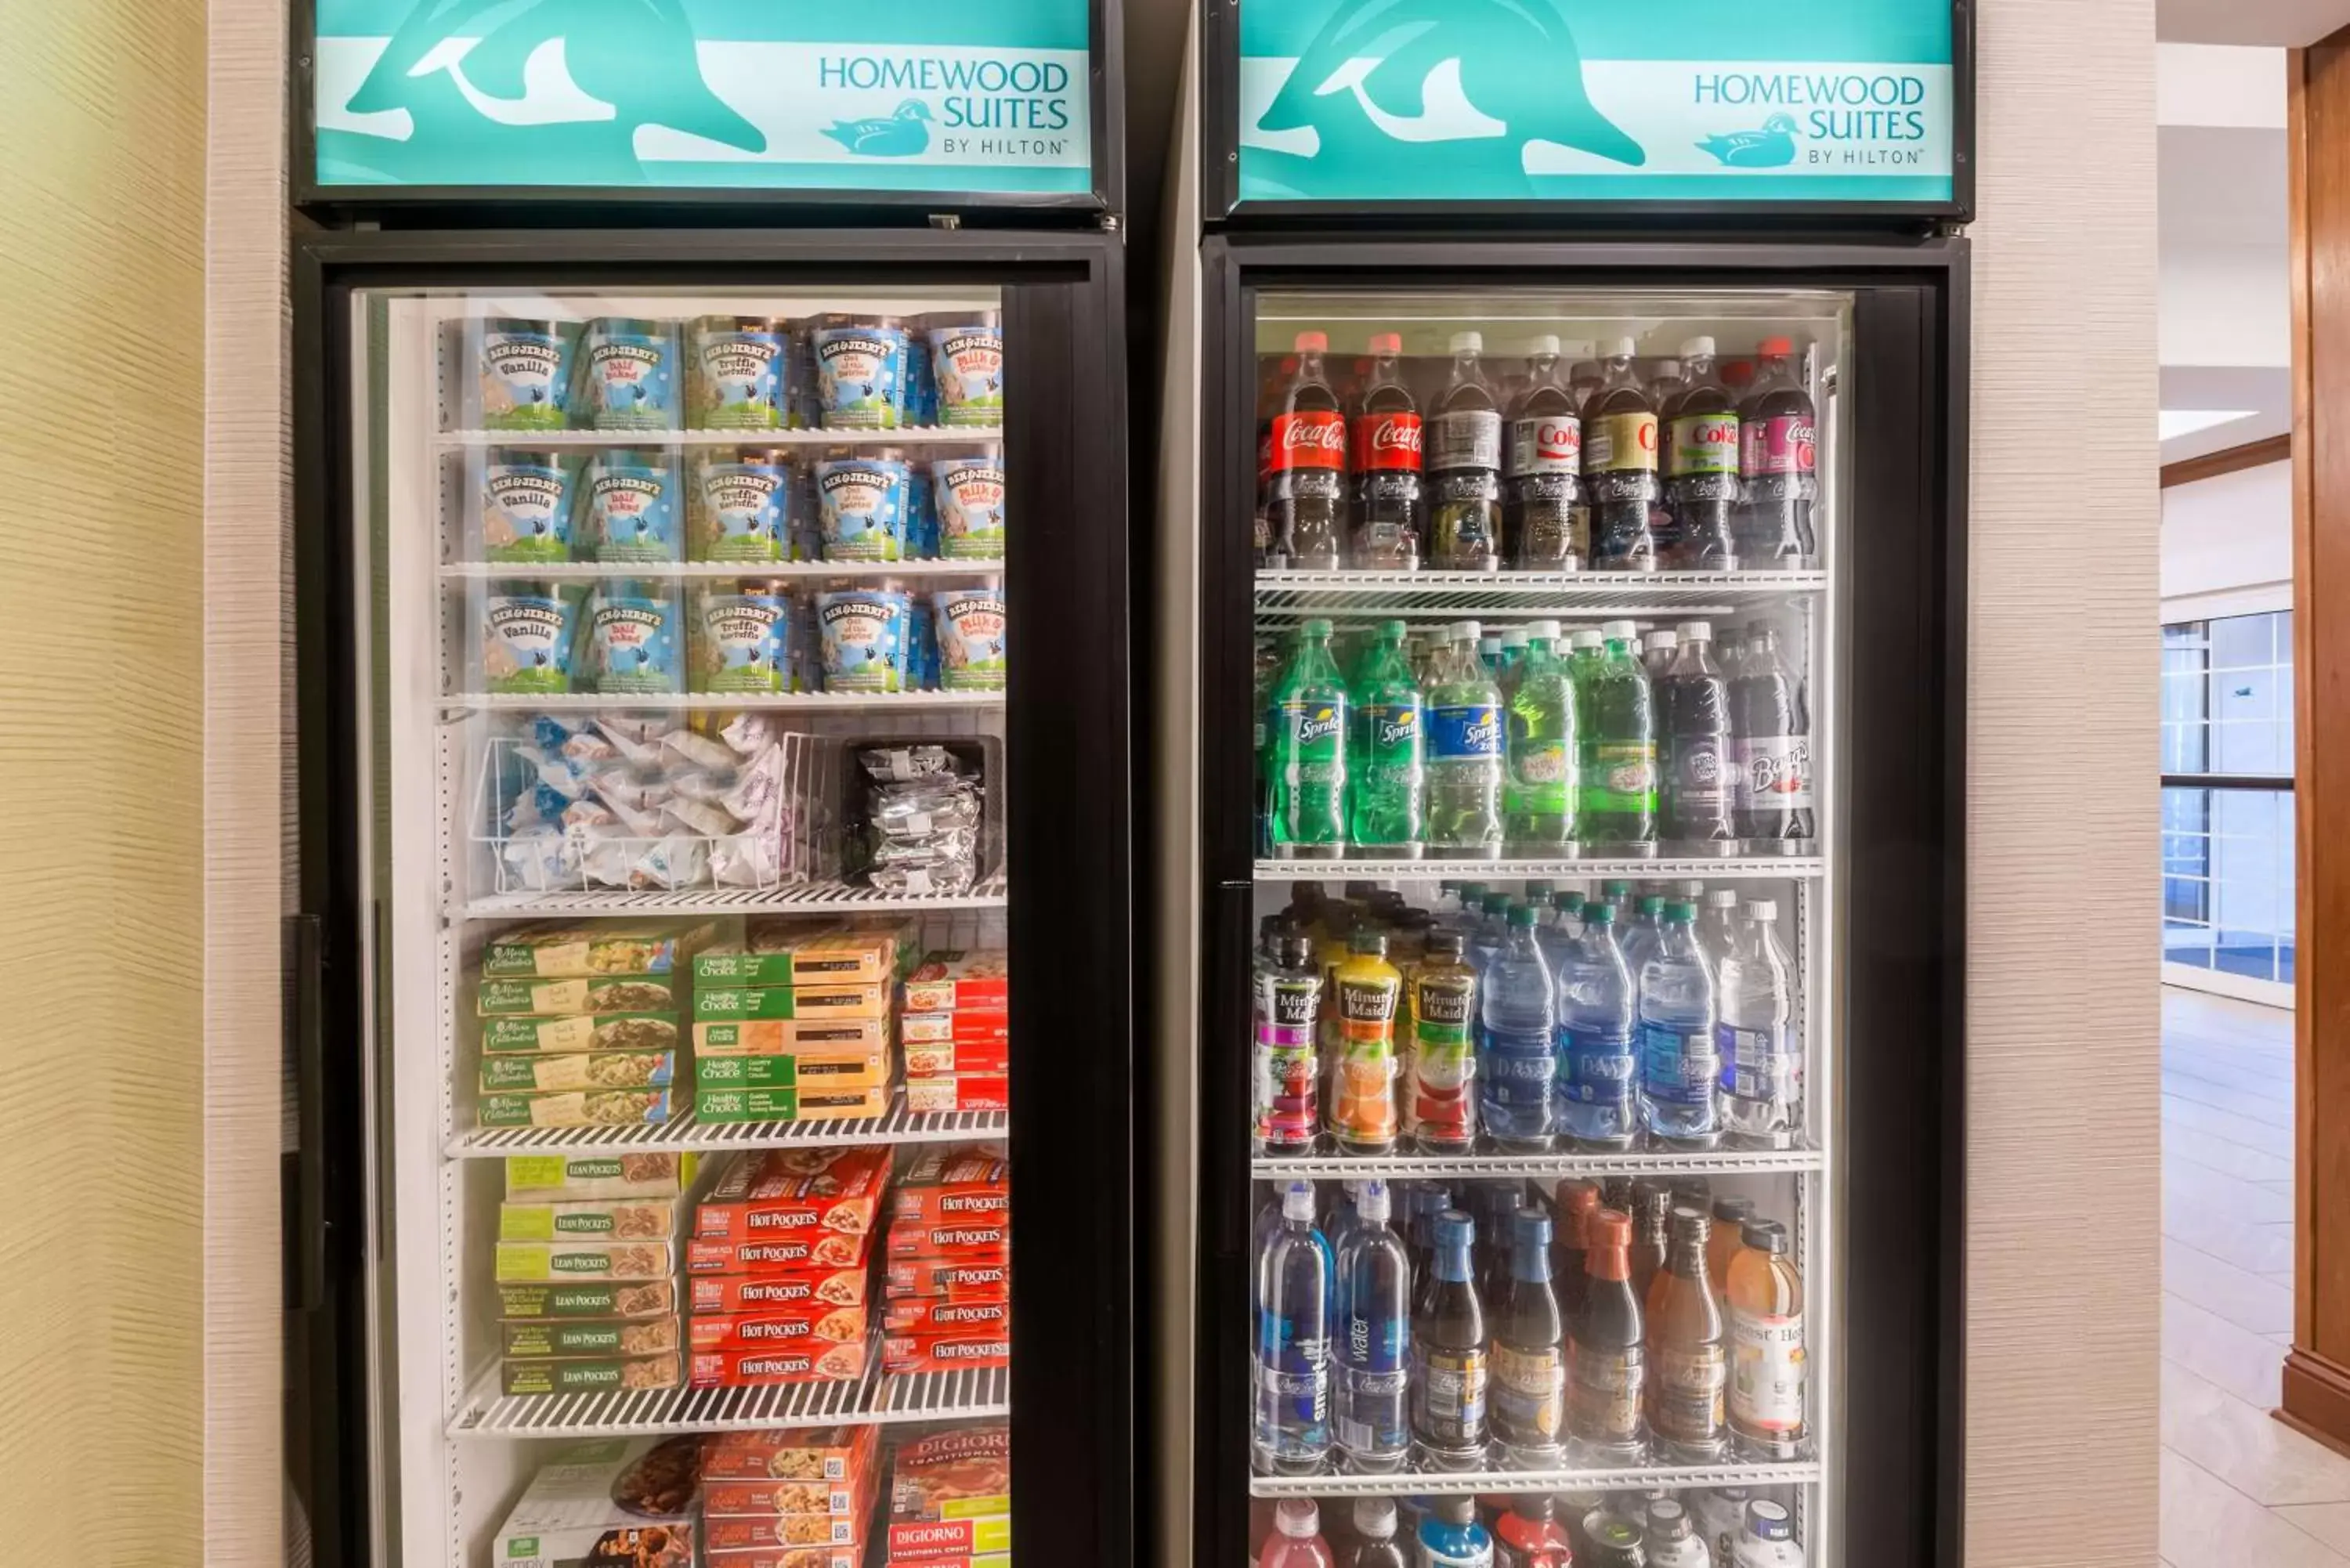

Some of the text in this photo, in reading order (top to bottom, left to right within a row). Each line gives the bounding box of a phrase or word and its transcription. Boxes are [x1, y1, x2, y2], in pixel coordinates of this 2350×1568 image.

[819, 57, 1068, 92] HOMEWOOD
[1694, 74, 1925, 105] HOMEWOOD
[943, 96, 1068, 129] SUITES
[1809, 110, 1925, 140] SUITES
[943, 139, 970, 153] BY
[1809, 150, 1833, 164] BY
[705, 958, 737, 970] Healthy
[700, 966, 738, 977] Choice
[706, 992, 739, 1003] Healthy
[700, 1001, 739, 1011] Choice
[1351, 1003, 1386, 1017] Maid
[1429, 1005, 1463, 1019] Maid
[707, 1060, 740, 1070] Healthy
[702, 1068, 740, 1078] Choice
[707, 1093, 741, 1104] Healthy
[703, 1101, 742, 1113] Choice
[569, 1164, 588, 1175] LEAN
[589, 1163, 620, 1175] POCKETS
[942, 1198, 964, 1210] HOT
[558, 1217, 611, 1229] LEAN POCKETS
[750, 1212, 817, 1227] HOT POCKETS
[933, 1232, 955, 1245] HOT
[956, 1229, 1000, 1243] POCKETS
[740, 1244, 808, 1260] HOT POCKETS
[554, 1256, 609, 1268] LEAN POCKETS
[958, 1269, 1003, 1282] POCKETS
[743, 1284, 811, 1300] HOT POCKETS
[555, 1294, 610, 1306] LEAN POCKETS
[935, 1306, 1002, 1322] HOT POCKETS
[742, 1324, 762, 1338] HOT
[764, 1321, 809, 1336] POCKETS
[563, 1332, 580, 1344] LEAN
[582, 1332, 616, 1344] POCKETS
[1351, 1317, 1369, 1362] water
[936, 1342, 1005, 1357] HOT POCKETS
[743, 1358, 809, 1375] HOT POCKETS
[564, 1371, 581, 1382] LEAN
[583, 1370, 618, 1382] POCKETS
[918, 1434, 1009, 1453] DIGIOR
[909, 1450, 1000, 1465] TRADITIONAL
[896, 1526, 964, 1545] DIGIORNO
[893, 1548, 942, 1558] TRADITIONAL
